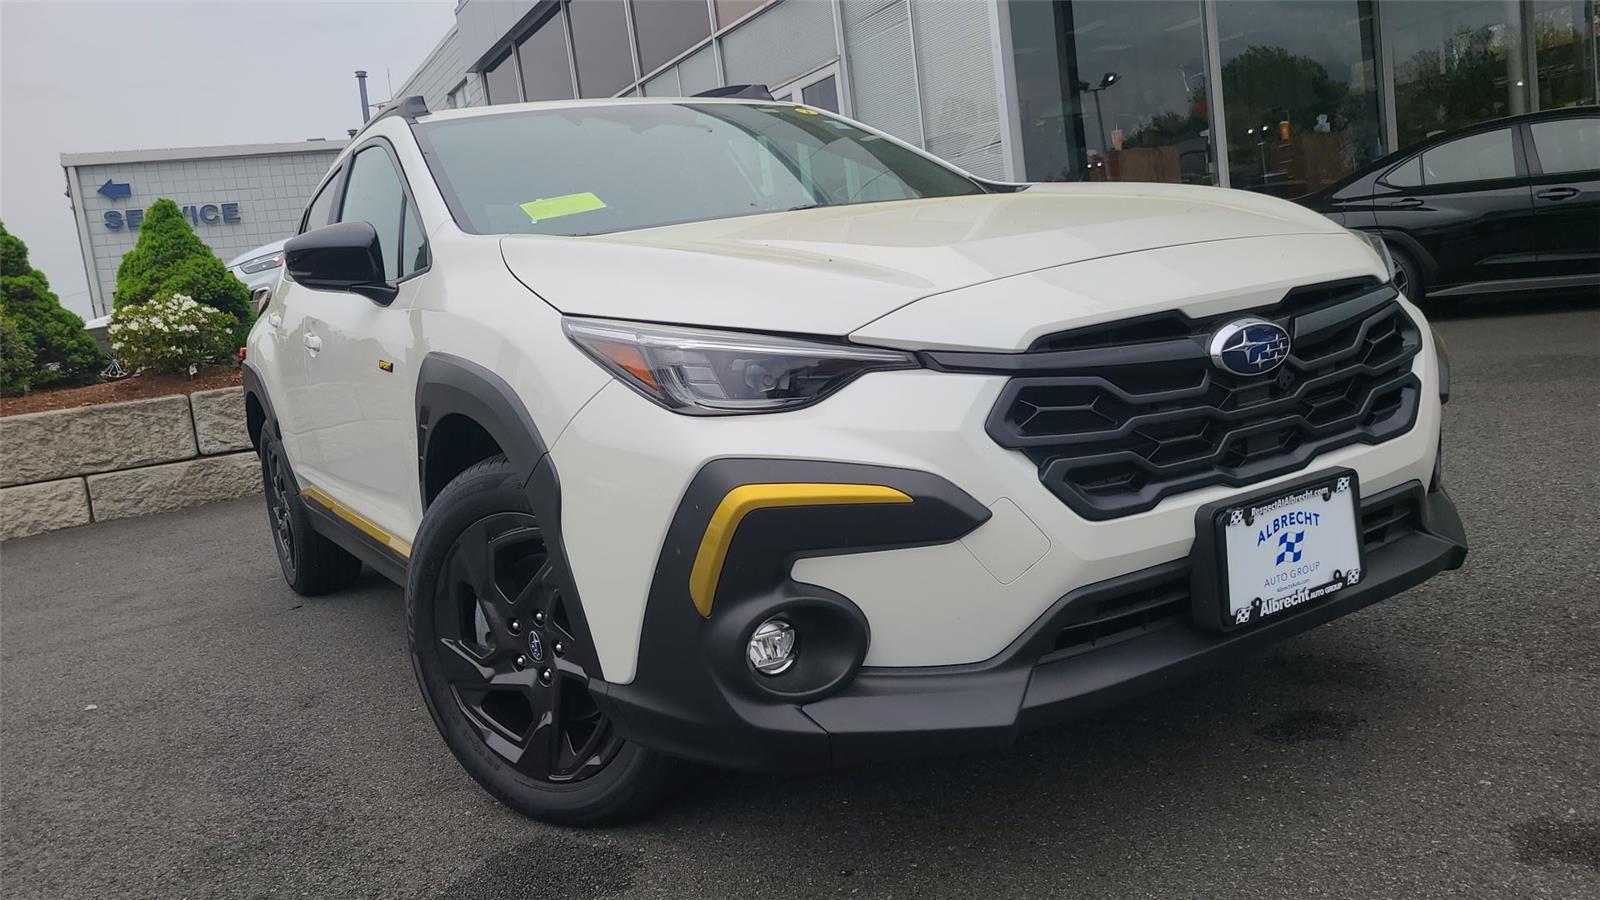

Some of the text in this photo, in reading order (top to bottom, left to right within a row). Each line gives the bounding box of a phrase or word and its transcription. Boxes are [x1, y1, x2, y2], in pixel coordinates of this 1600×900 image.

[104, 203, 241, 231] SEICE
[1257, 511, 1320, 546] ALBRECHT
[1264, 561, 1320, 588] AUTO GROUP
[1260, 582, 1343, 617] Albrecht AUTO GROUP
